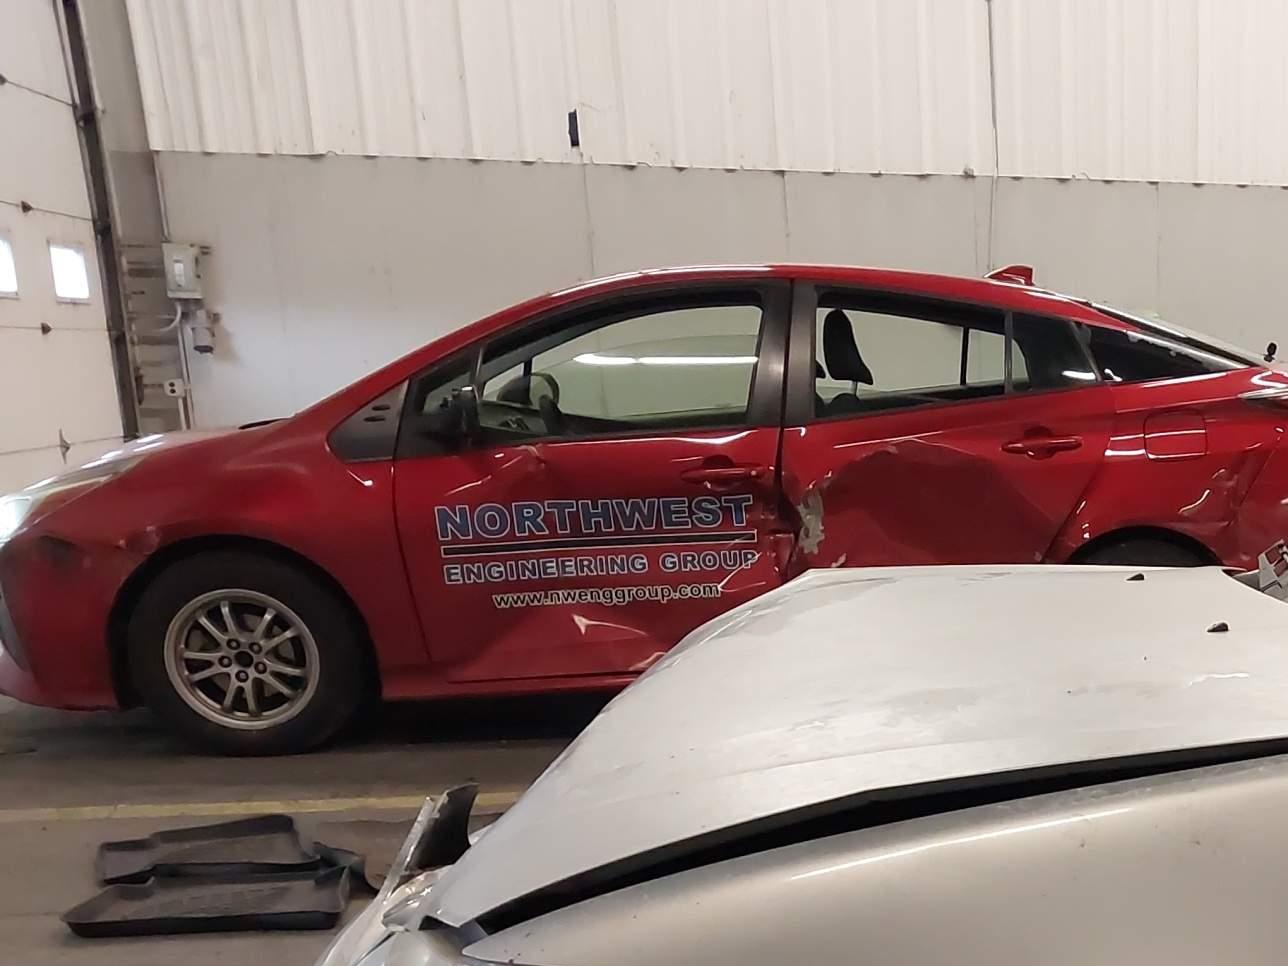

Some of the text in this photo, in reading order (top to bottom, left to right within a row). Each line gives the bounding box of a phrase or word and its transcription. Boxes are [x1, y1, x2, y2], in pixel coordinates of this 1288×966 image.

[434, 494, 754, 541] NORTHWEST
[443, 549, 759, 585] ENGINEERING GROUP
[492, 583, 721, 609] www.nwenggroup.com
